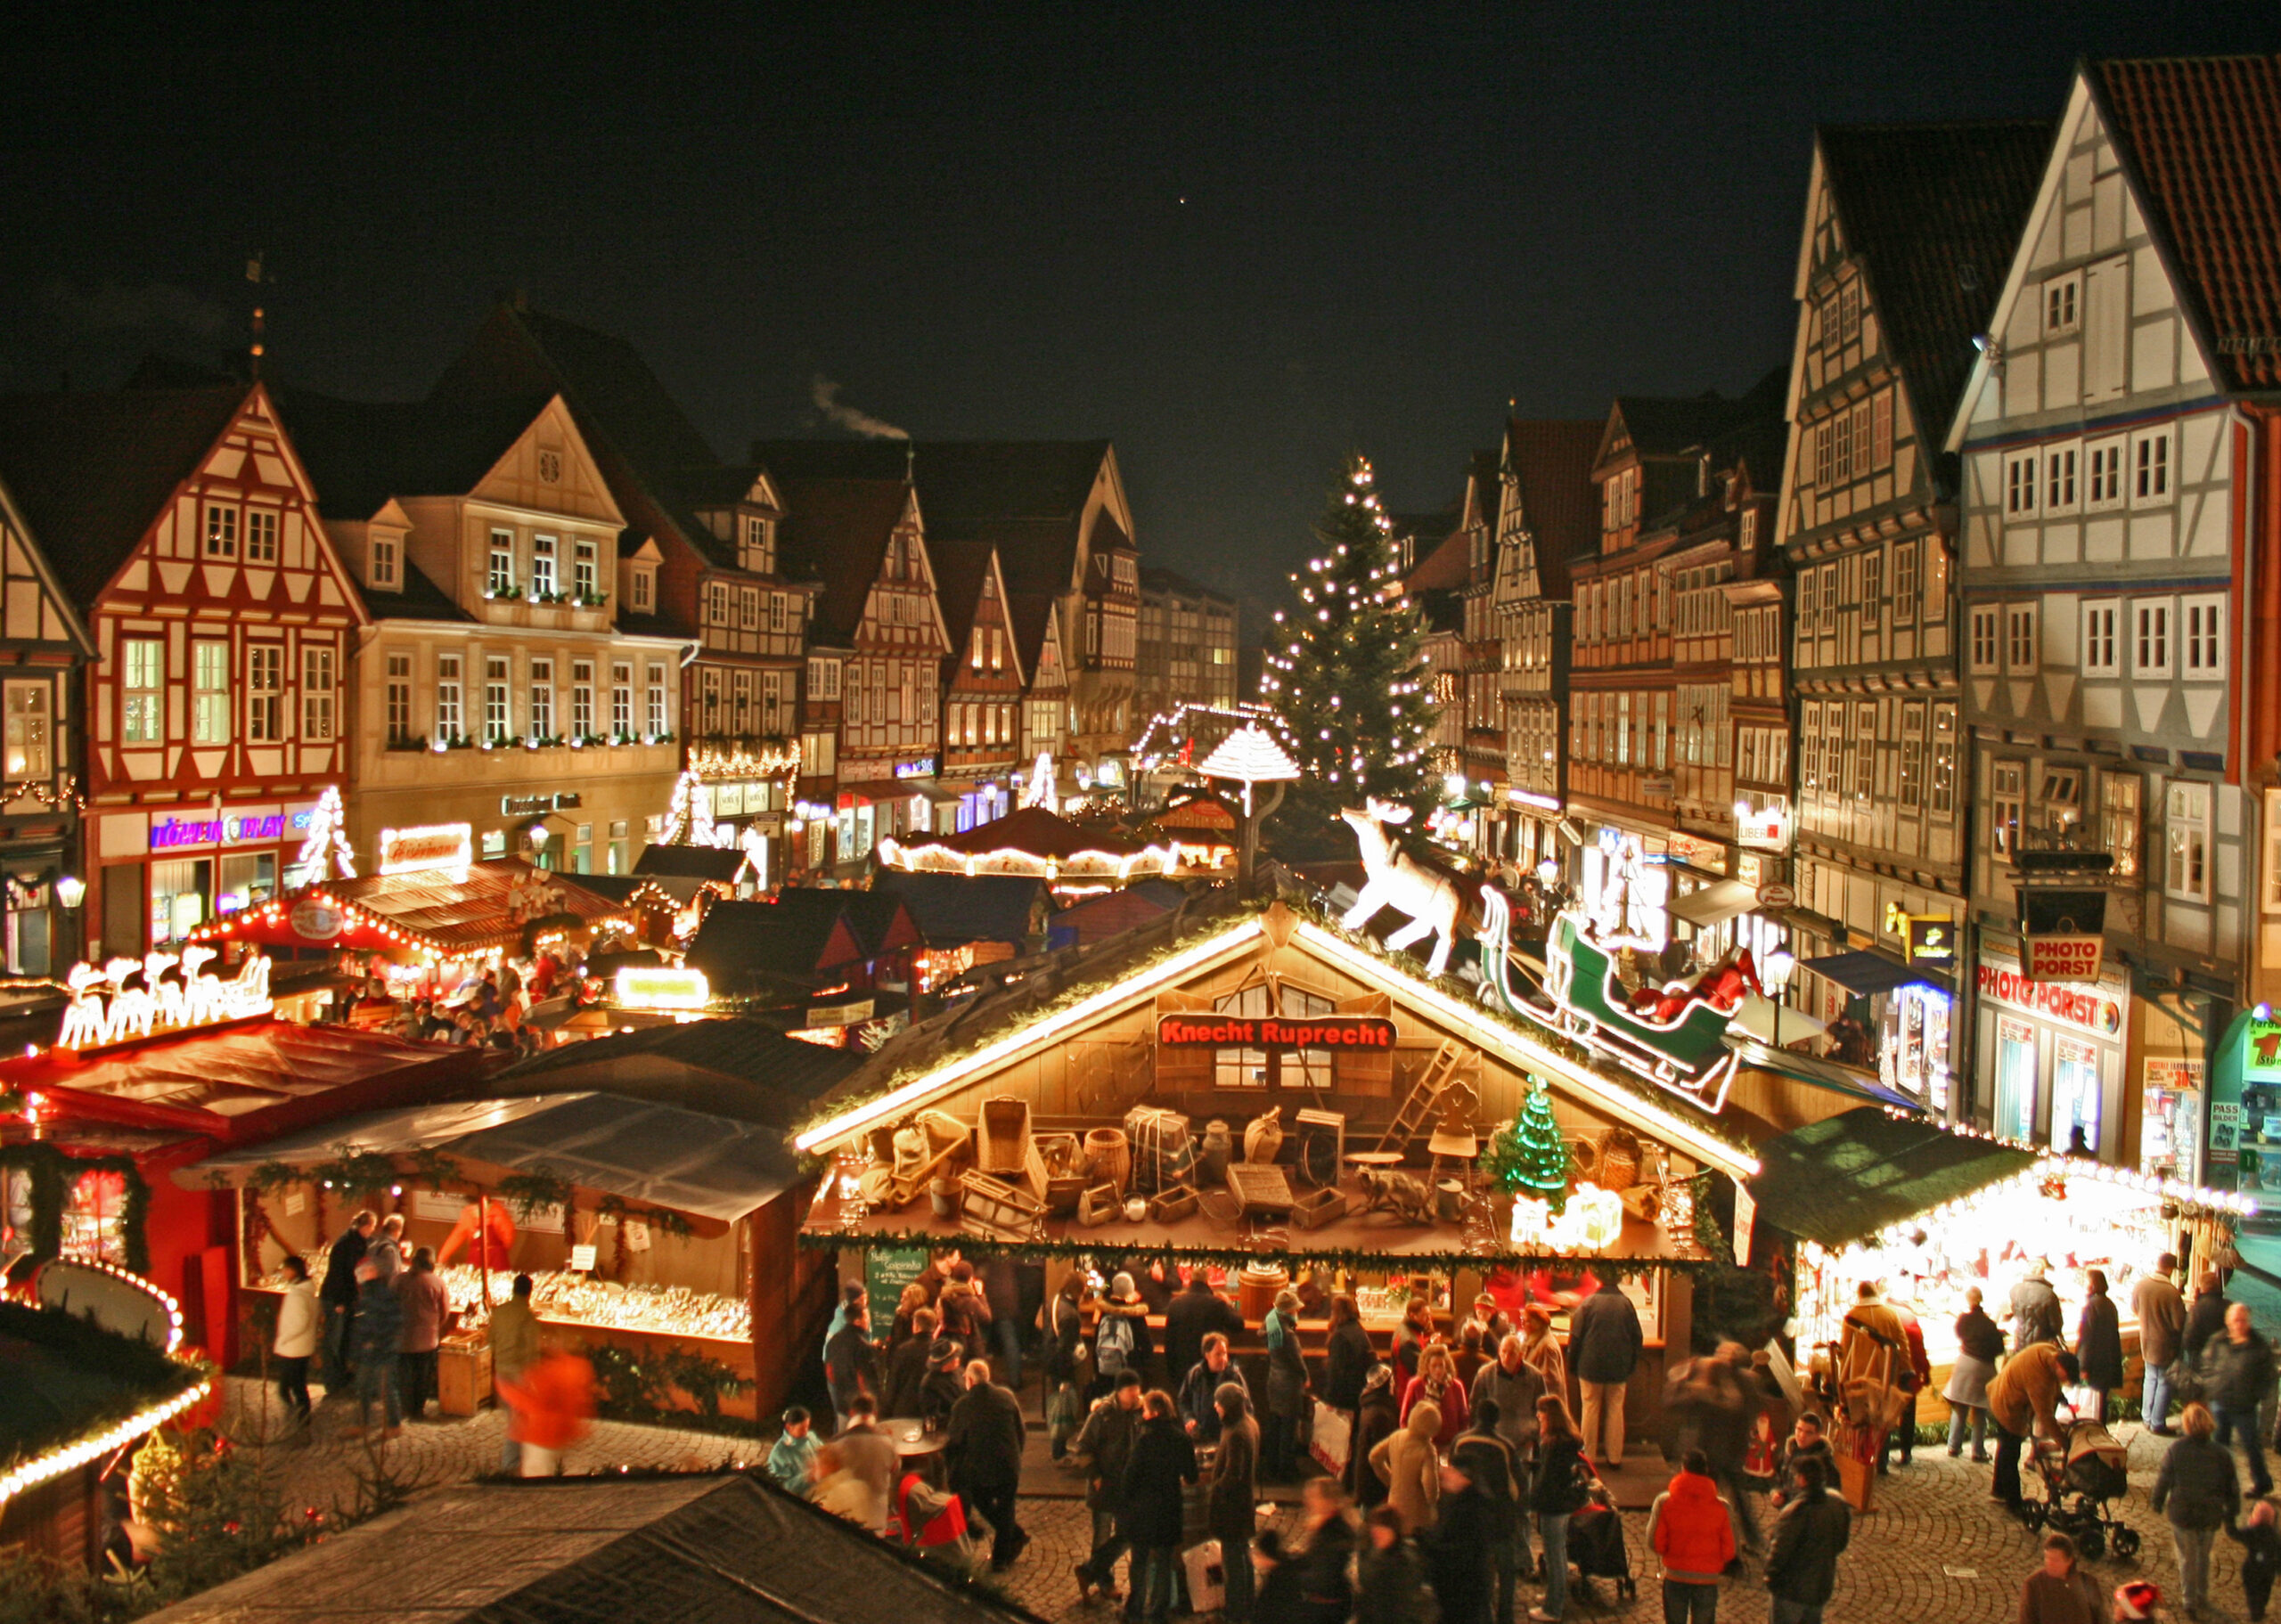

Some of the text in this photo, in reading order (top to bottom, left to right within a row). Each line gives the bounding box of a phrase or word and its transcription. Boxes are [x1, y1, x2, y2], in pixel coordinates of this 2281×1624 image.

[2033, 942, 2097, 958] PHOTO
[2032, 959, 2095, 975] PORST
[1978, 965, 2097, 1026] PHOTO PORST
[1162, 1021, 1389, 1048] Knecht Ruprecht
[2213, 1105, 2238, 1114] PASS
